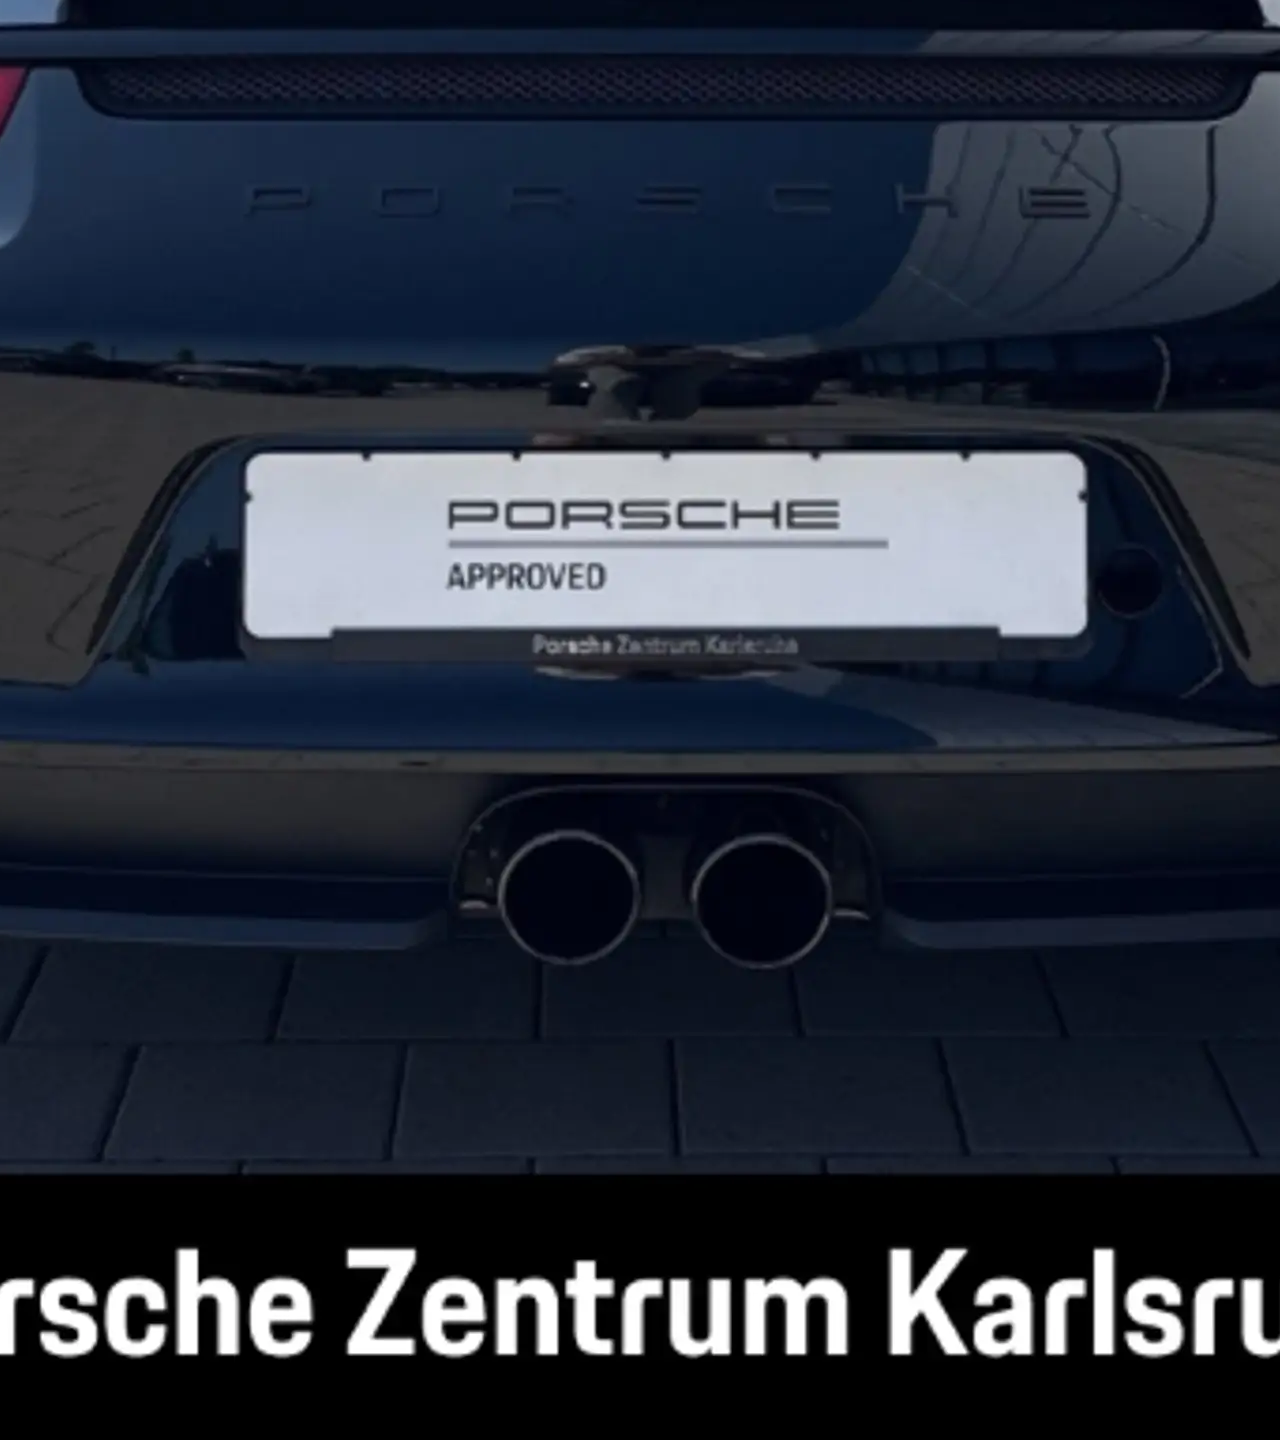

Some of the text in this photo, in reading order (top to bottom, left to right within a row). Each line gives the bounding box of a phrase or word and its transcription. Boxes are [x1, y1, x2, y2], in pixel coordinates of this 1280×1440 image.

[244, 183, 1092, 220] PORSCHE
[447, 500, 841, 531] PORSCHE
[446, 562, 607, 591] APPROVED
[532, 633, 612, 655] Porsche
[616, 633, 701, 655] Zentrum
